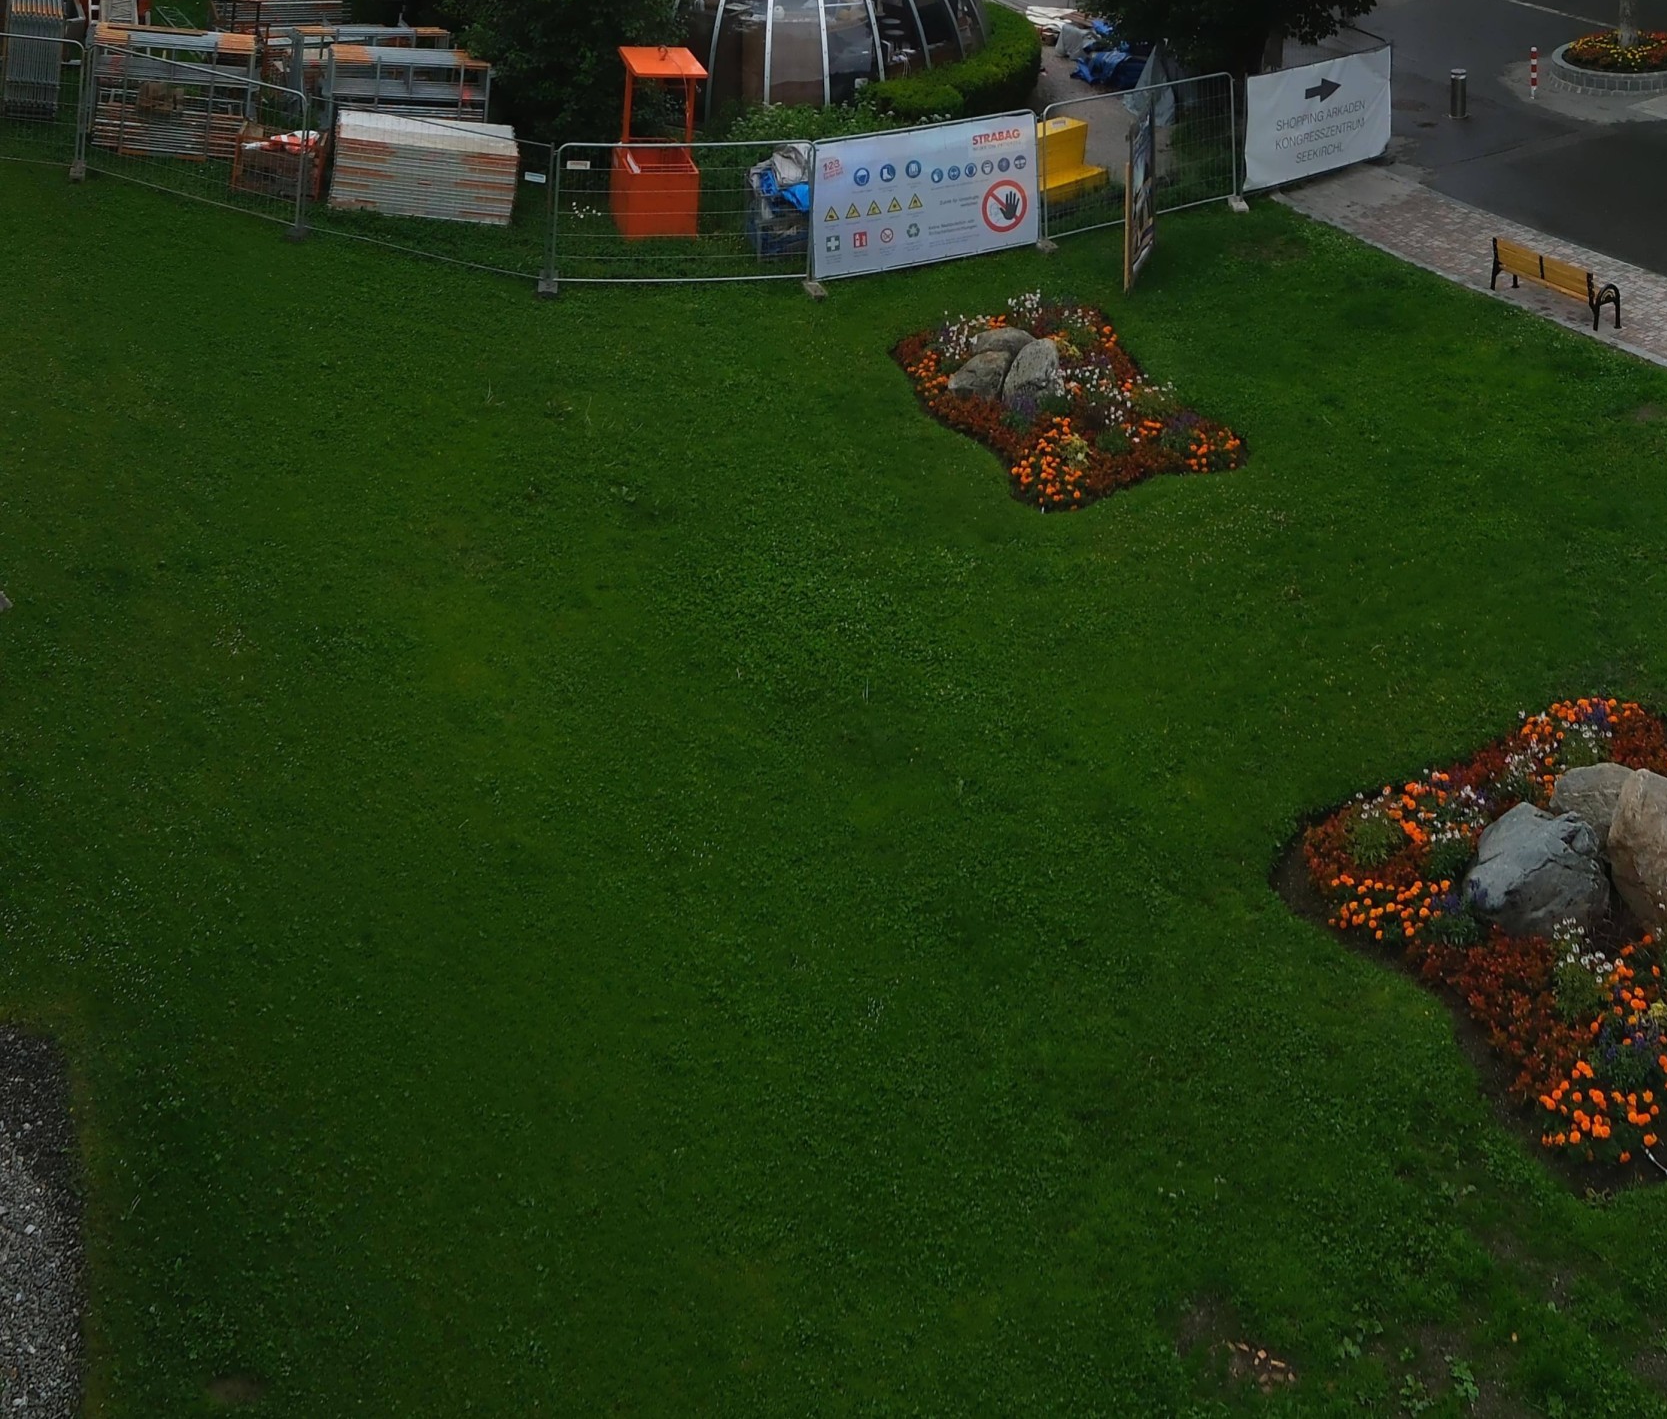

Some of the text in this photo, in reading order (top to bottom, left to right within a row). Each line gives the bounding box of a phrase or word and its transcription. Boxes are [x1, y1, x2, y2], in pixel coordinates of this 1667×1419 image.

[1276, 100, 1365, 131] SHOPPING ARKADEN
[972, 129, 1020, 145] STRABAG
[1276, 117, 1365, 150] KONGRESSZENTRUM
